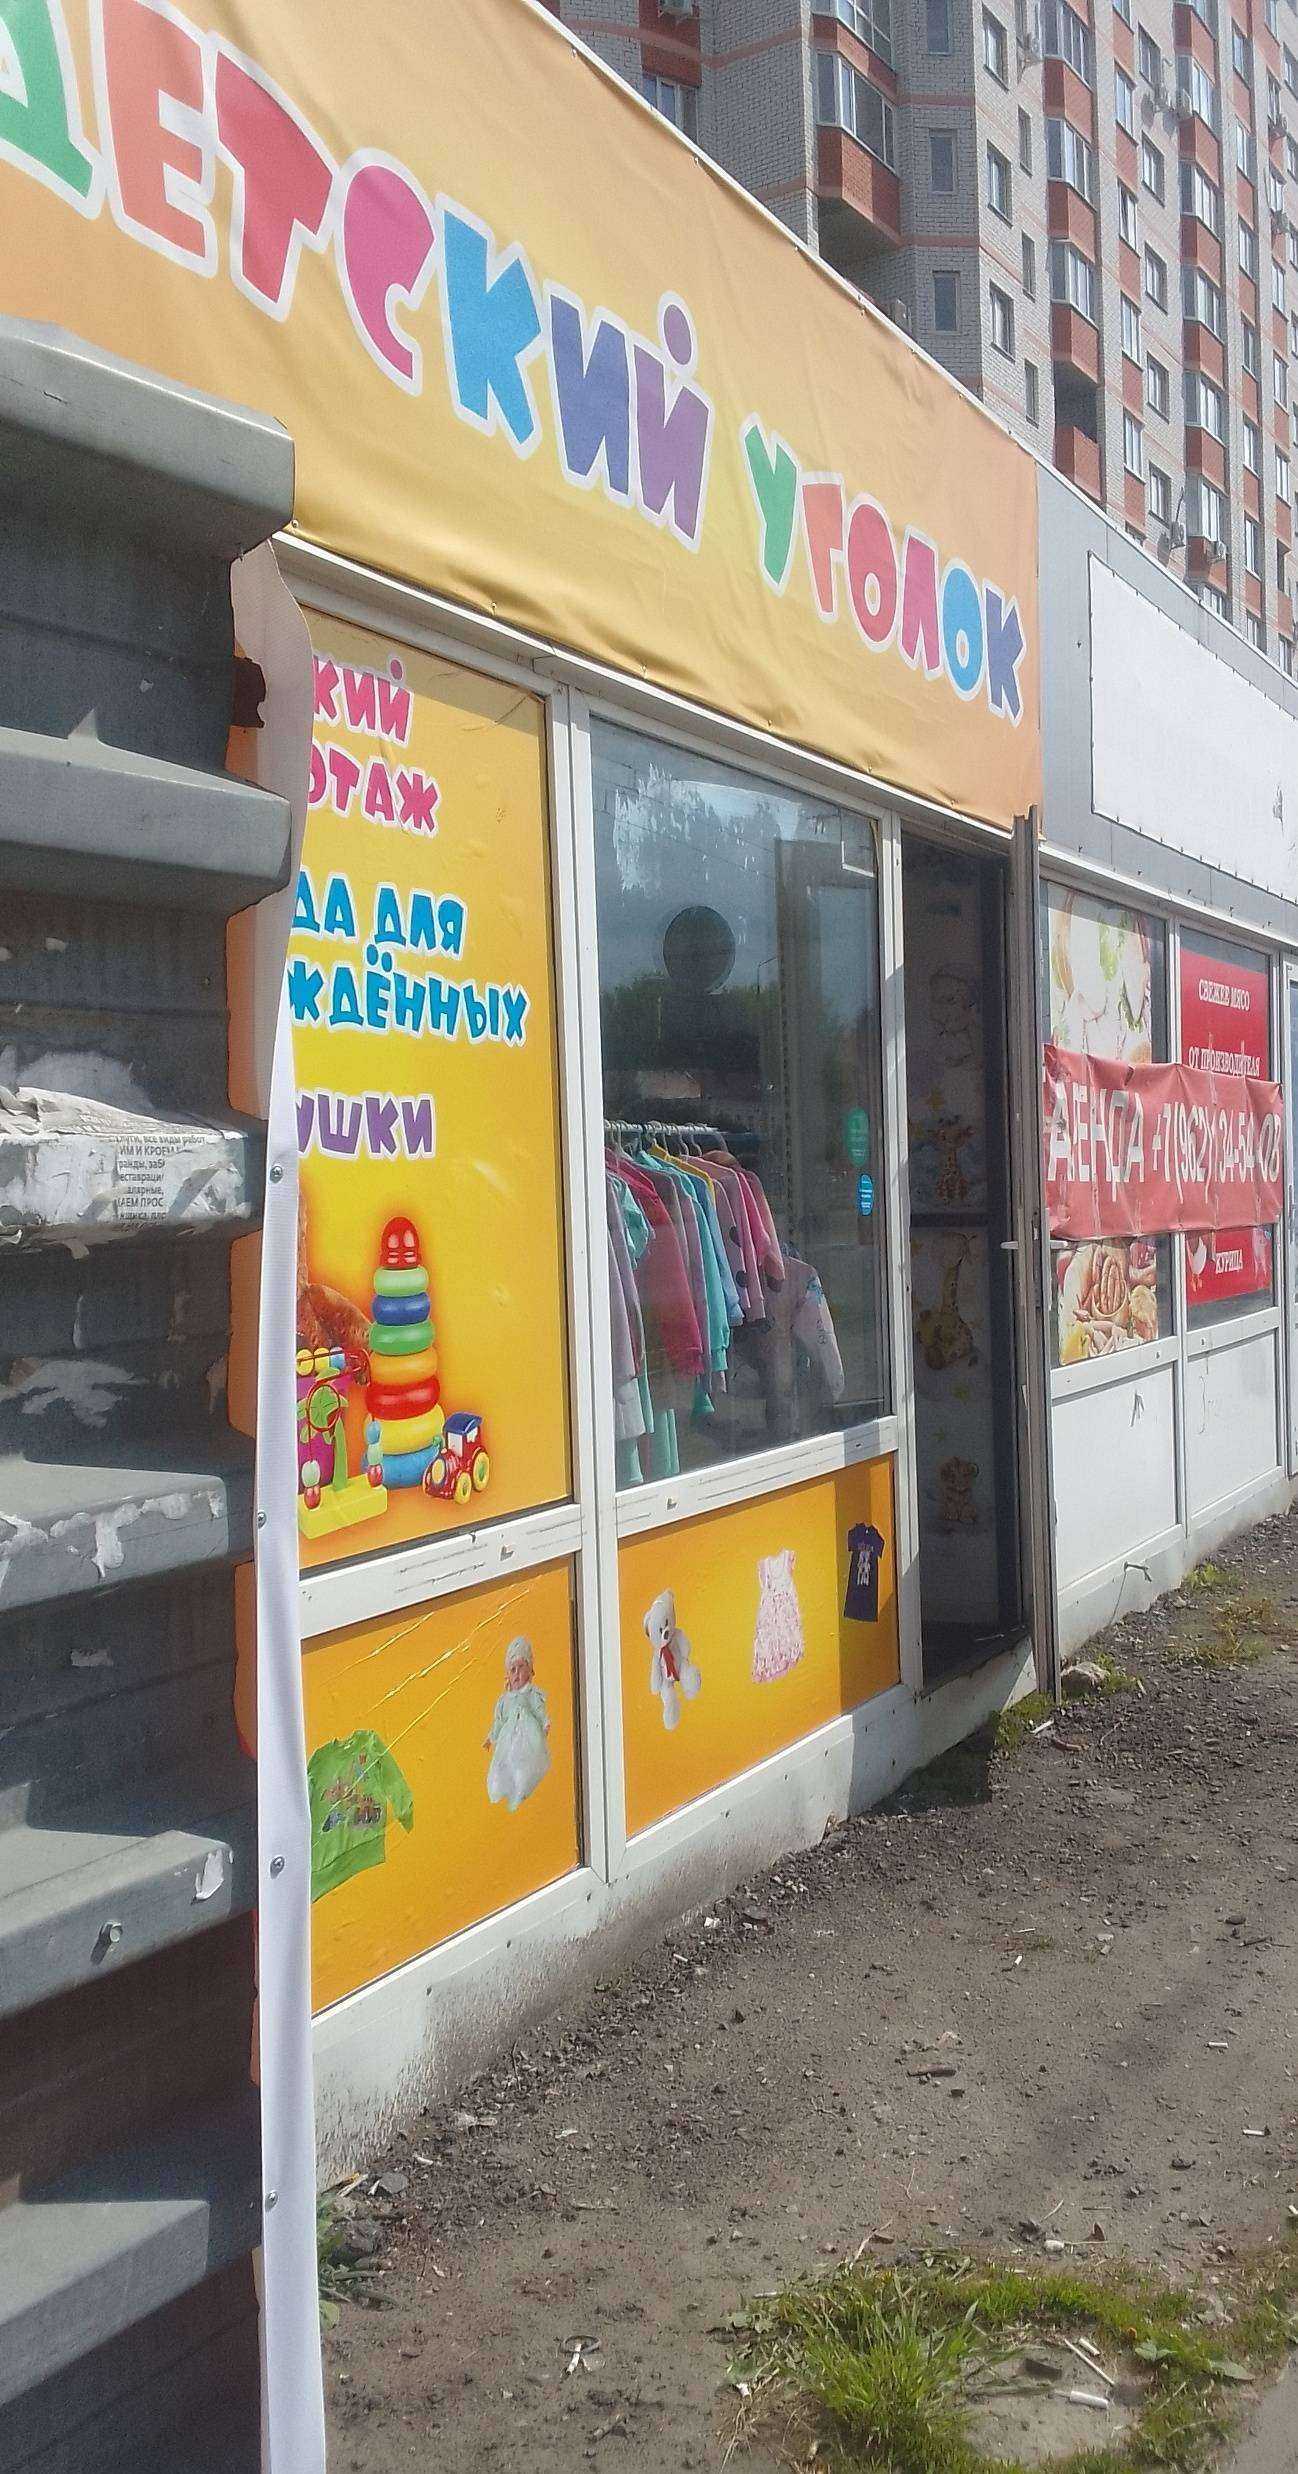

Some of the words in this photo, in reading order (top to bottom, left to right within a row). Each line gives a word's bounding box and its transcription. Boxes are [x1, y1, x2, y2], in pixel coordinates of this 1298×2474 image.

[743, 417, 1025, 723] УГОЛОК
[375, 887, 463, 954] ДЛЯ
[1230, 987, 1250, 1011] МЯСО
[1188, 1046, 1200, 1068] ОТ
[1047, 1082, 1144, 1202] АЕНДА
